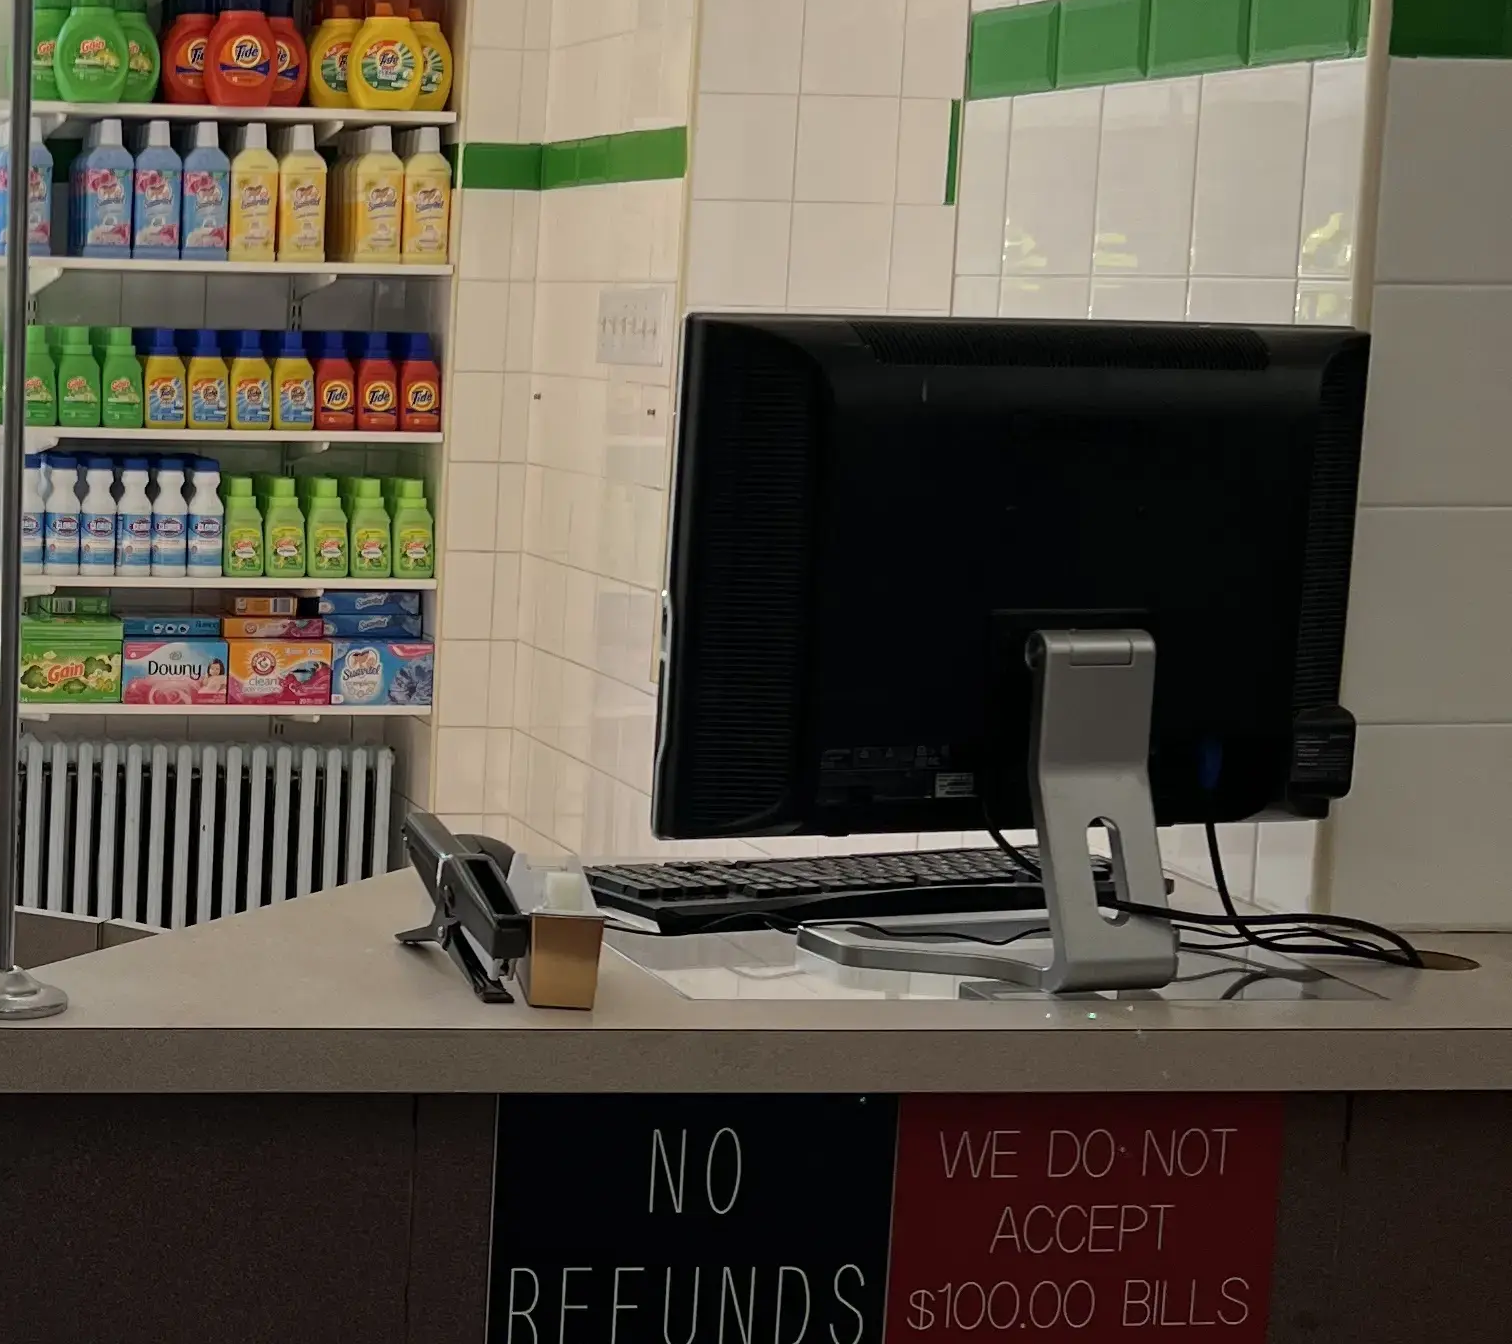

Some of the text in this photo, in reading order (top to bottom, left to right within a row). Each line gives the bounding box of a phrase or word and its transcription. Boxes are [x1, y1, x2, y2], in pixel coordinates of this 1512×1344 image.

[235, 43, 259, 61] Tide
[326, 387, 348, 405] Tide
[369, 388, 390, 405] Tide
[411, 388, 433, 406] Tide
[47, 663, 85, 685] Gain
[148, 660, 202, 681] Downy
[343, 664, 381, 681] Suavitel
[248, 676, 277, 687] clean
[939, 1128, 1238, 1179] WE DO NOT
[649, 1127, 742, 1215] NO
[989, 1204, 1176, 1254] ACCEPT
[906, 1277, 1251, 1331] $100.00 BILLS
